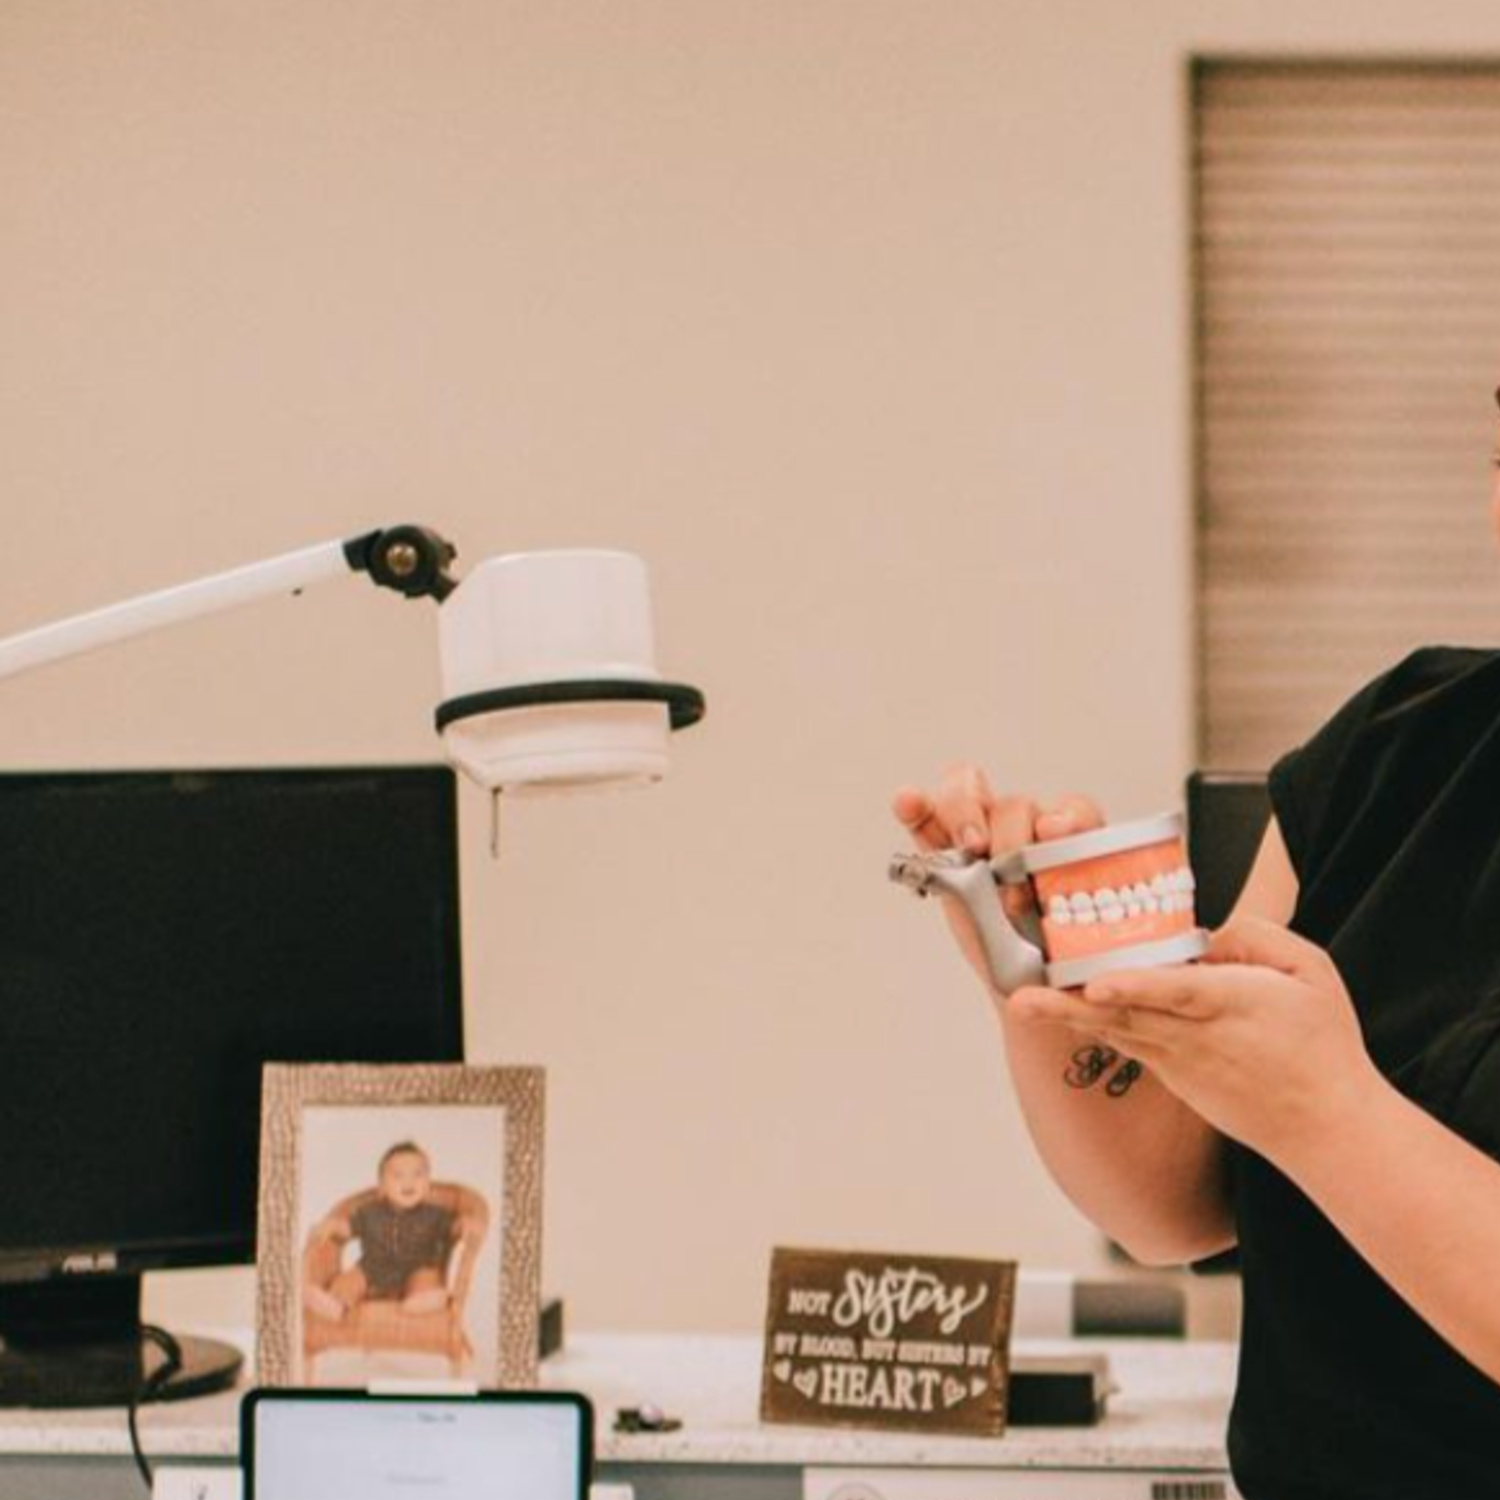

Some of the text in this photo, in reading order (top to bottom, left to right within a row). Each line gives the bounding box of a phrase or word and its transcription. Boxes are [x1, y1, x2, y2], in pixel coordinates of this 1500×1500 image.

[788, 1266, 988, 1337] NOT Sisters
[820, 1363, 942, 1412] HEART
